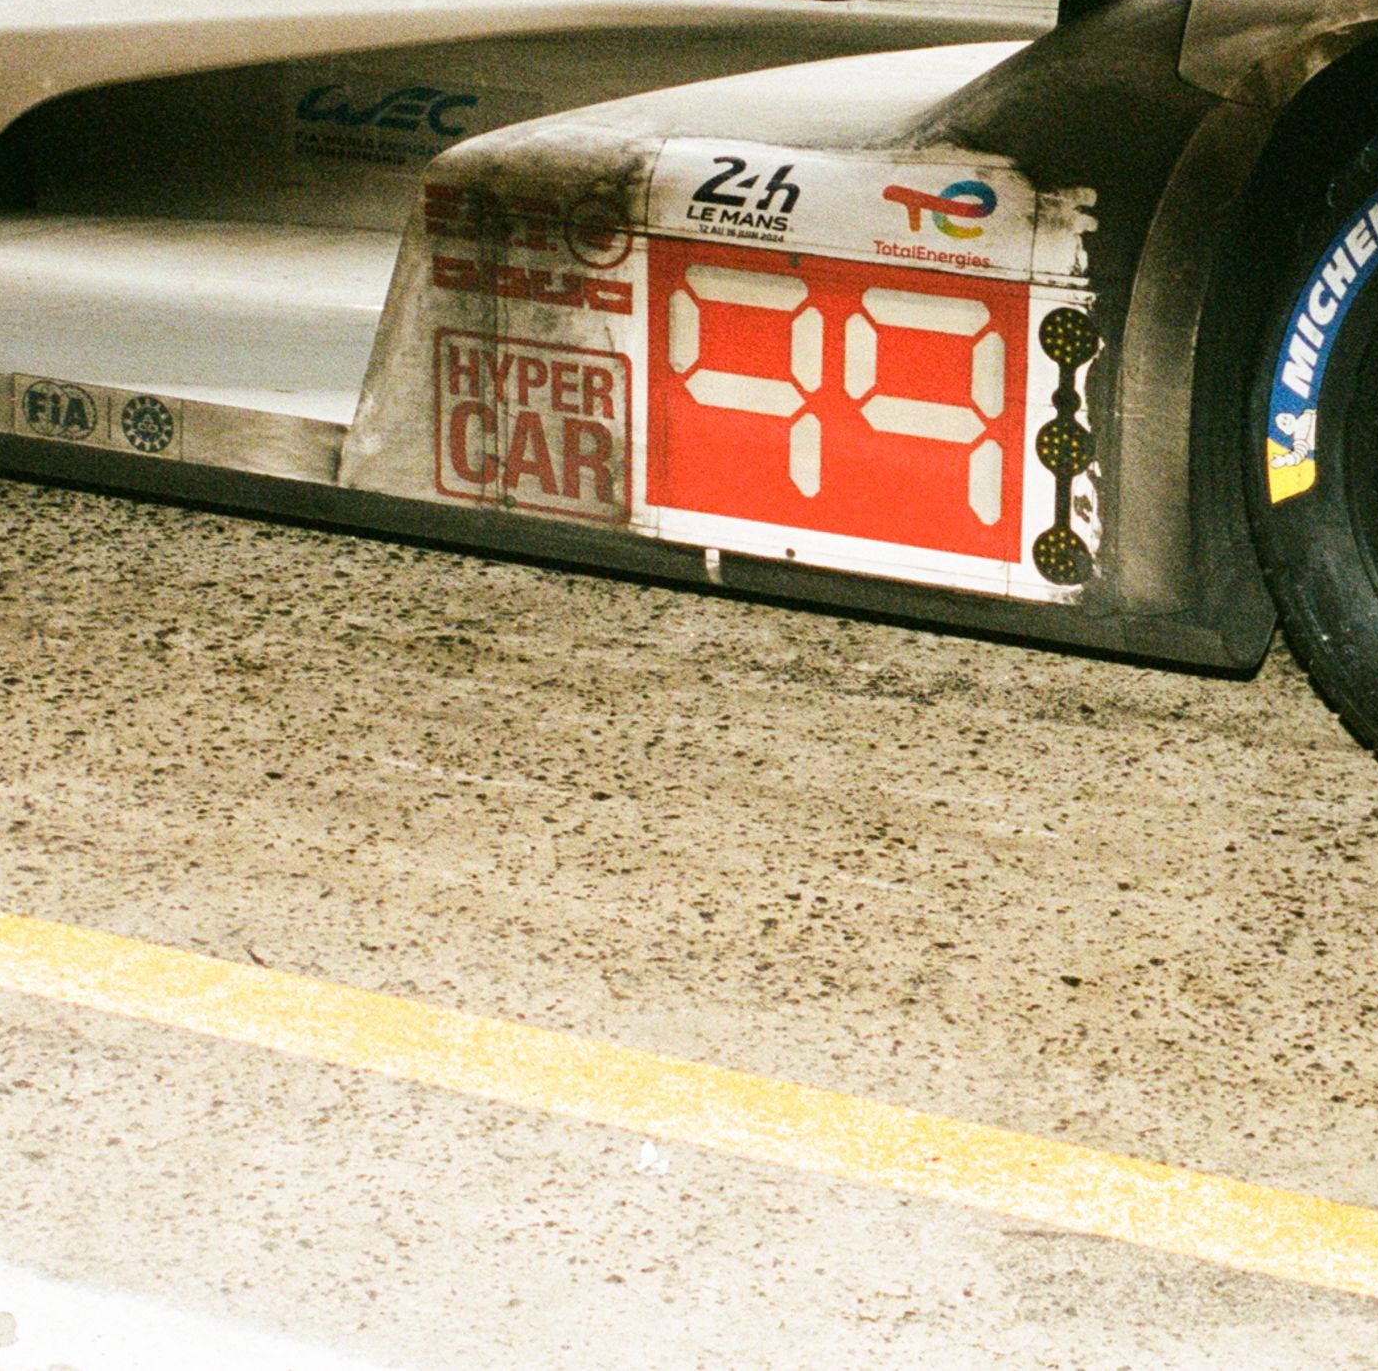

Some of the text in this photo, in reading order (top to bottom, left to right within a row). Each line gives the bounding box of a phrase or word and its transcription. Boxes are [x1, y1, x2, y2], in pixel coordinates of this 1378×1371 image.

[691, 156, 801, 213] 24h
[686, 204, 789, 232] LE MANS
[873, 240, 991, 270] TotalEnergies
[449, 336, 615, 422] HYPER
[669, 264, 1005, 526] 99
[26, 390, 90, 430] FIA
[449, 402, 615, 505] CAR
